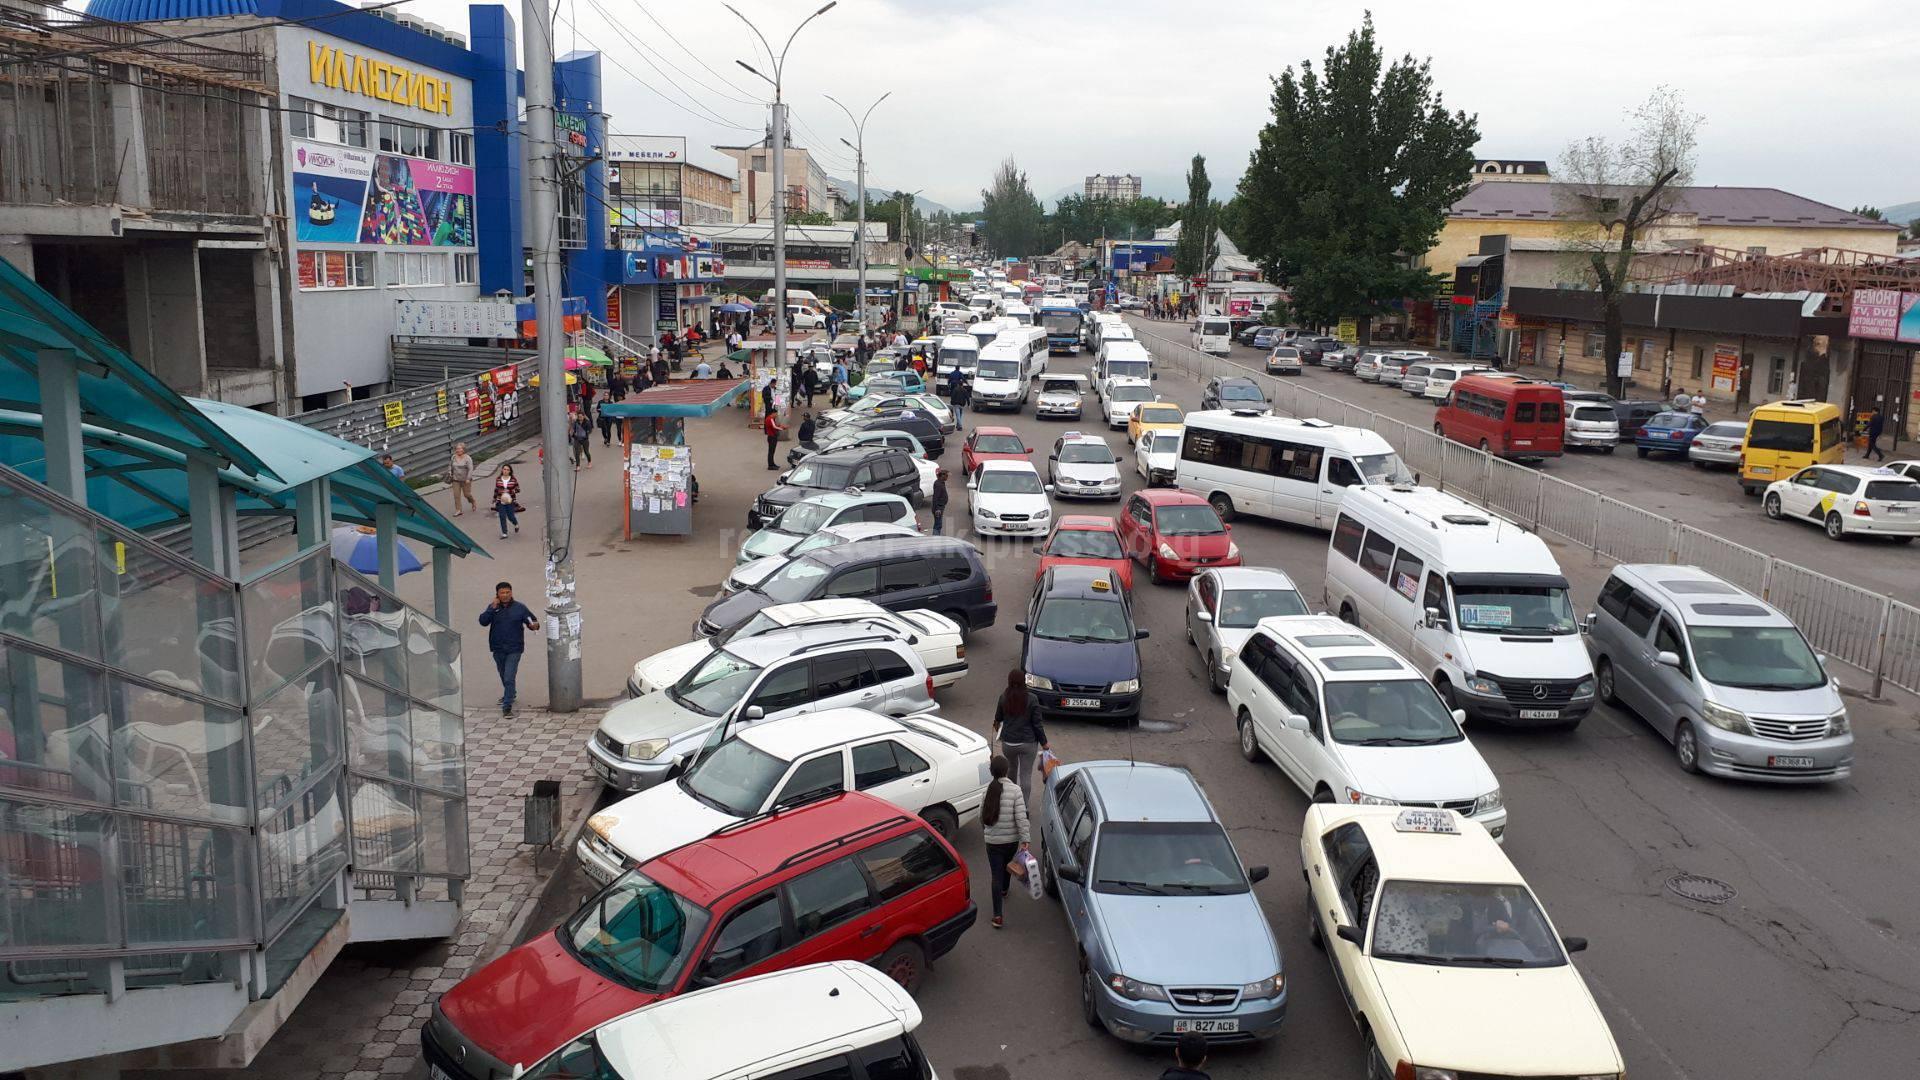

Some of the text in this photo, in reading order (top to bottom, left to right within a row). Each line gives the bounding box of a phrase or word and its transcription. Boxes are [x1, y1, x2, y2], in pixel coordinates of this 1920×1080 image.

[629, 151, 663, 159] МЕБЕЛИ
[436, 176, 442, 188] 2
[1853, 289, 1899, 305] РЕМОНТ
[1854, 306, 1897, 318] TV, DVD
[1461, 608, 1478, 622] 104
[1195, 1020, 1215, 1031] 827
[1217, 1022, 1235, 1031] ACB
